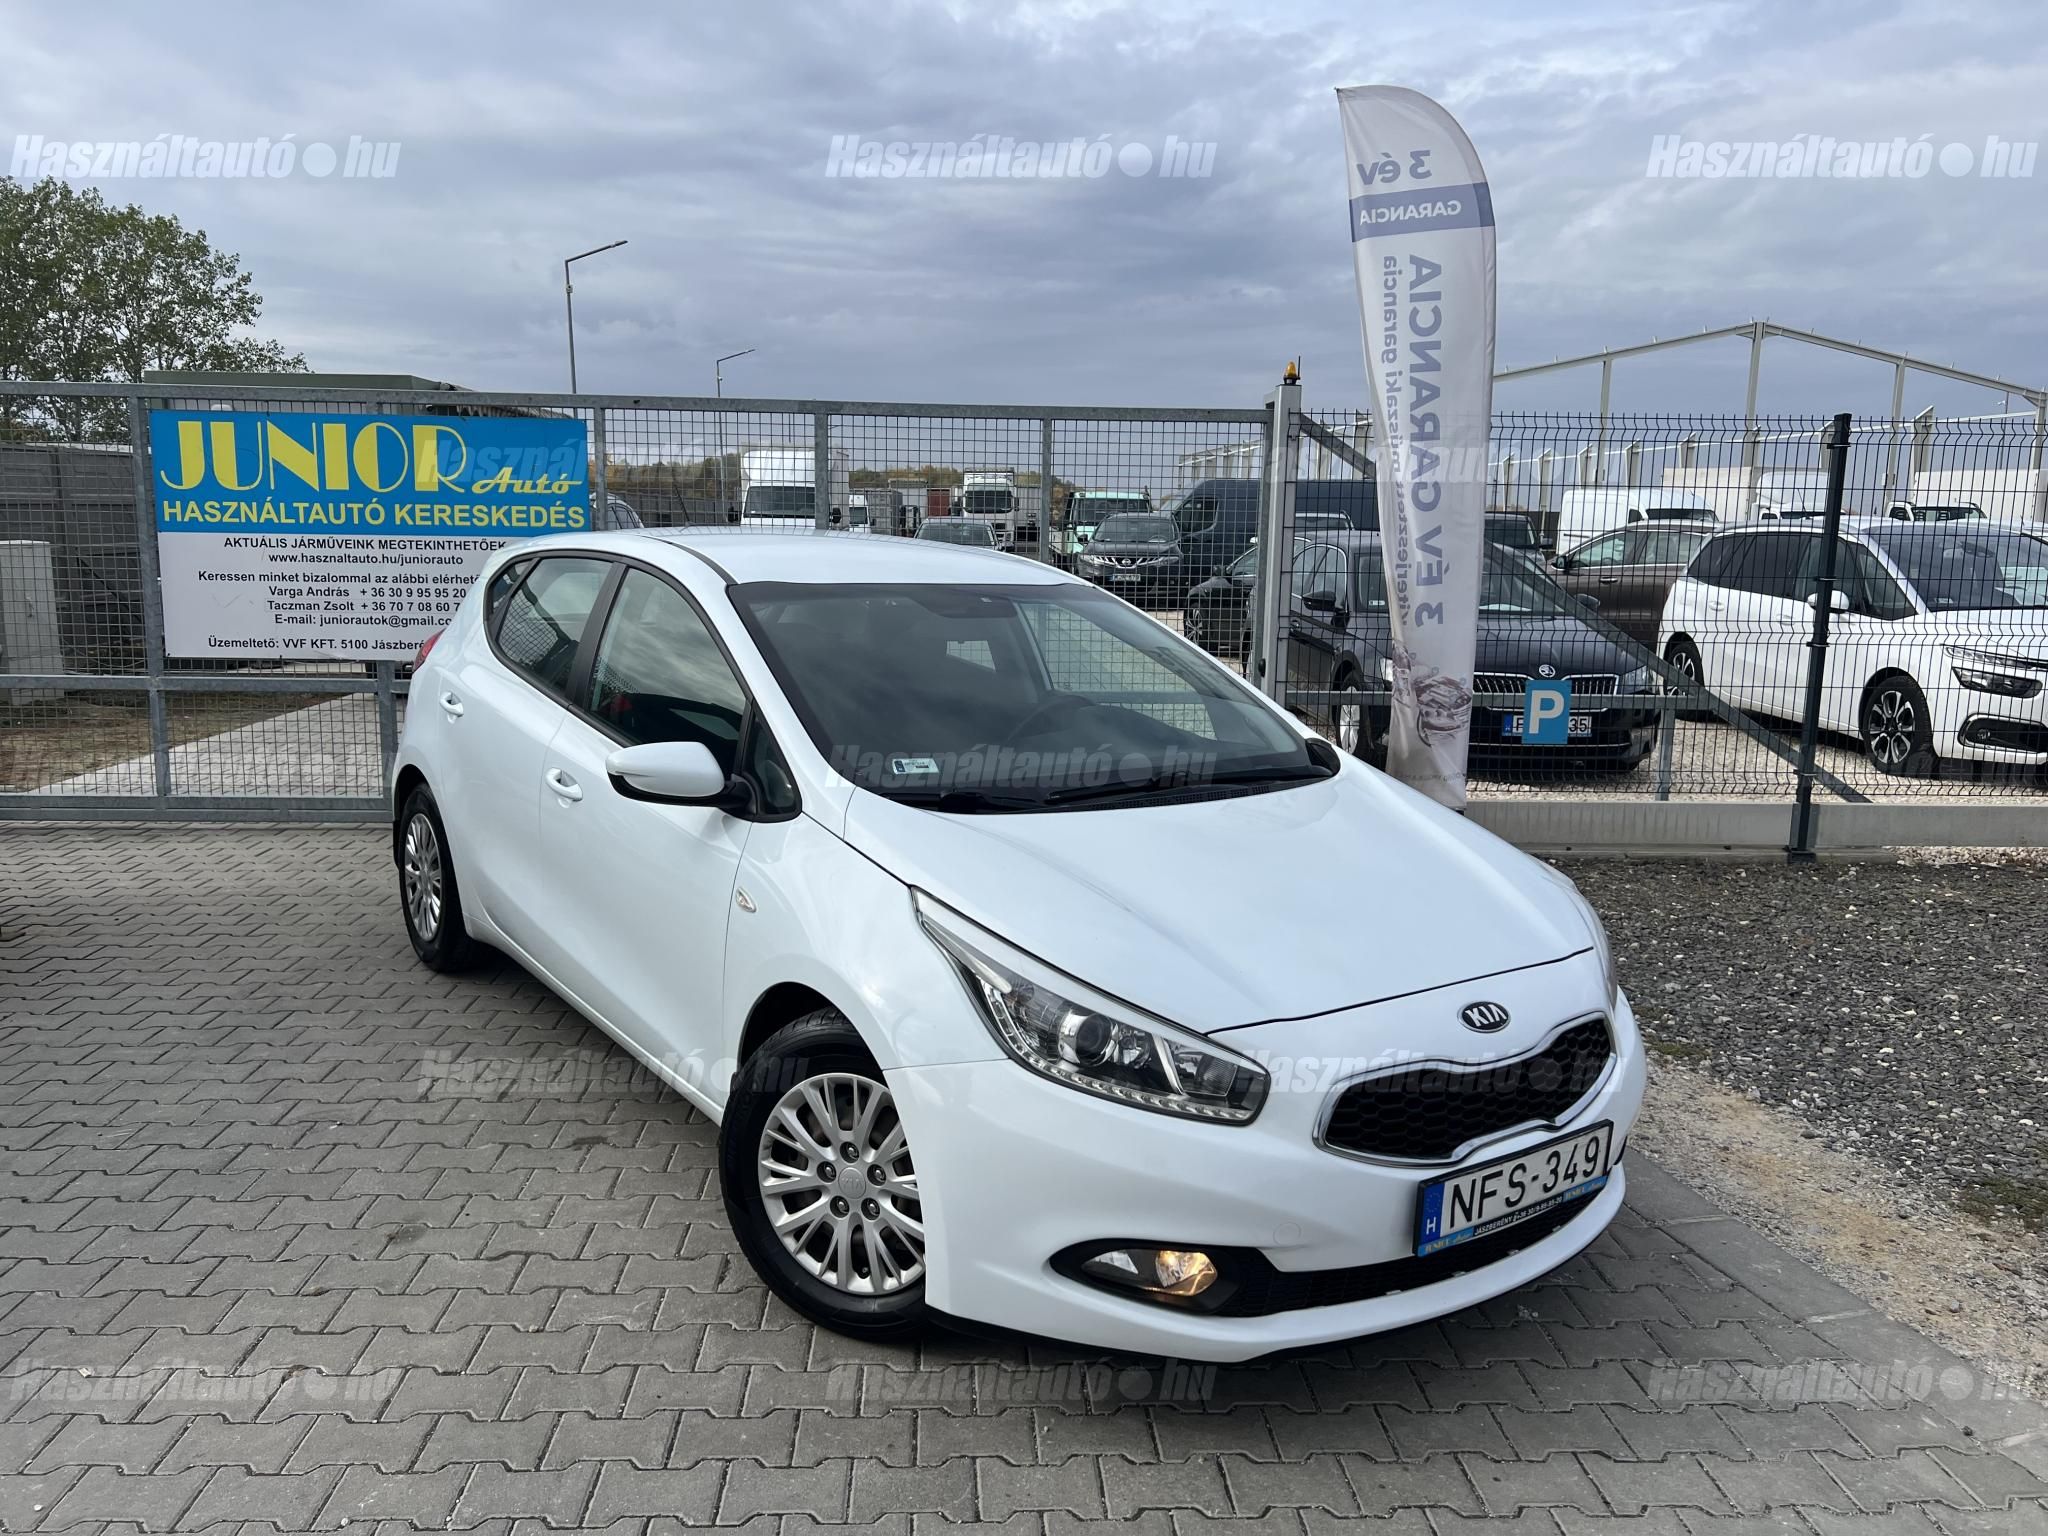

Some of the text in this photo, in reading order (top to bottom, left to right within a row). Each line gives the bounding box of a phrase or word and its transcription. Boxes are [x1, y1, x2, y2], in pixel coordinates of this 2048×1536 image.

[160, 419, 583, 495] JUNIOR Autó
[163, 496, 585, 528] HASZNÁLTAUTÓ KERESKEDÉS
[224, 535, 506, 551] AKTUÁLIS JÁRMŰVEINK MEGTEKINTHETŐEK
[269, 552, 464, 567] www.hasznaltauto.hu/juniorauto
[199, 570, 255, 581] Keressen
[259, 571, 299, 582] minket
[303, 572, 371, 583] bizalommal
[375, 575, 388, 584] az
[392, 573, 428, 584] alábbi
[268, 585, 303, 598] Varga
[306, 586, 350, 597] András
[371, 587, 385, 598] 36
[388, 587, 402, 598] 30
[406, 587, 413, 598] 9
[416, 588, 430, 598] 95
[434, 588, 449, 598] 95
[452, 588, 466, 599] 20
[267, 600, 320, 611] Taczman
[323, 601, 354, 611] Zsolt
[372, 602, 386, 612] 36
[389, 602, 403, 612] 70
[407, 602, 414, 612] 7
[417, 602, 431, 612] 08
[436, 602, 450, 612] 60
[274, 613, 316, 625] E-mail:
[208, 634, 279, 649] Üzemeltető:
[283, 638, 307, 649] VVF
[310, 639, 337, 649] KFT.
[341, 639, 368, 650] 5100
[1529, 689, 1565, 734] P
[1464, 1003, 1508, 1028] KIA
[1450, 1135, 1601, 1230] NFS-349
[1426, 1216, 1437, 1235] H
